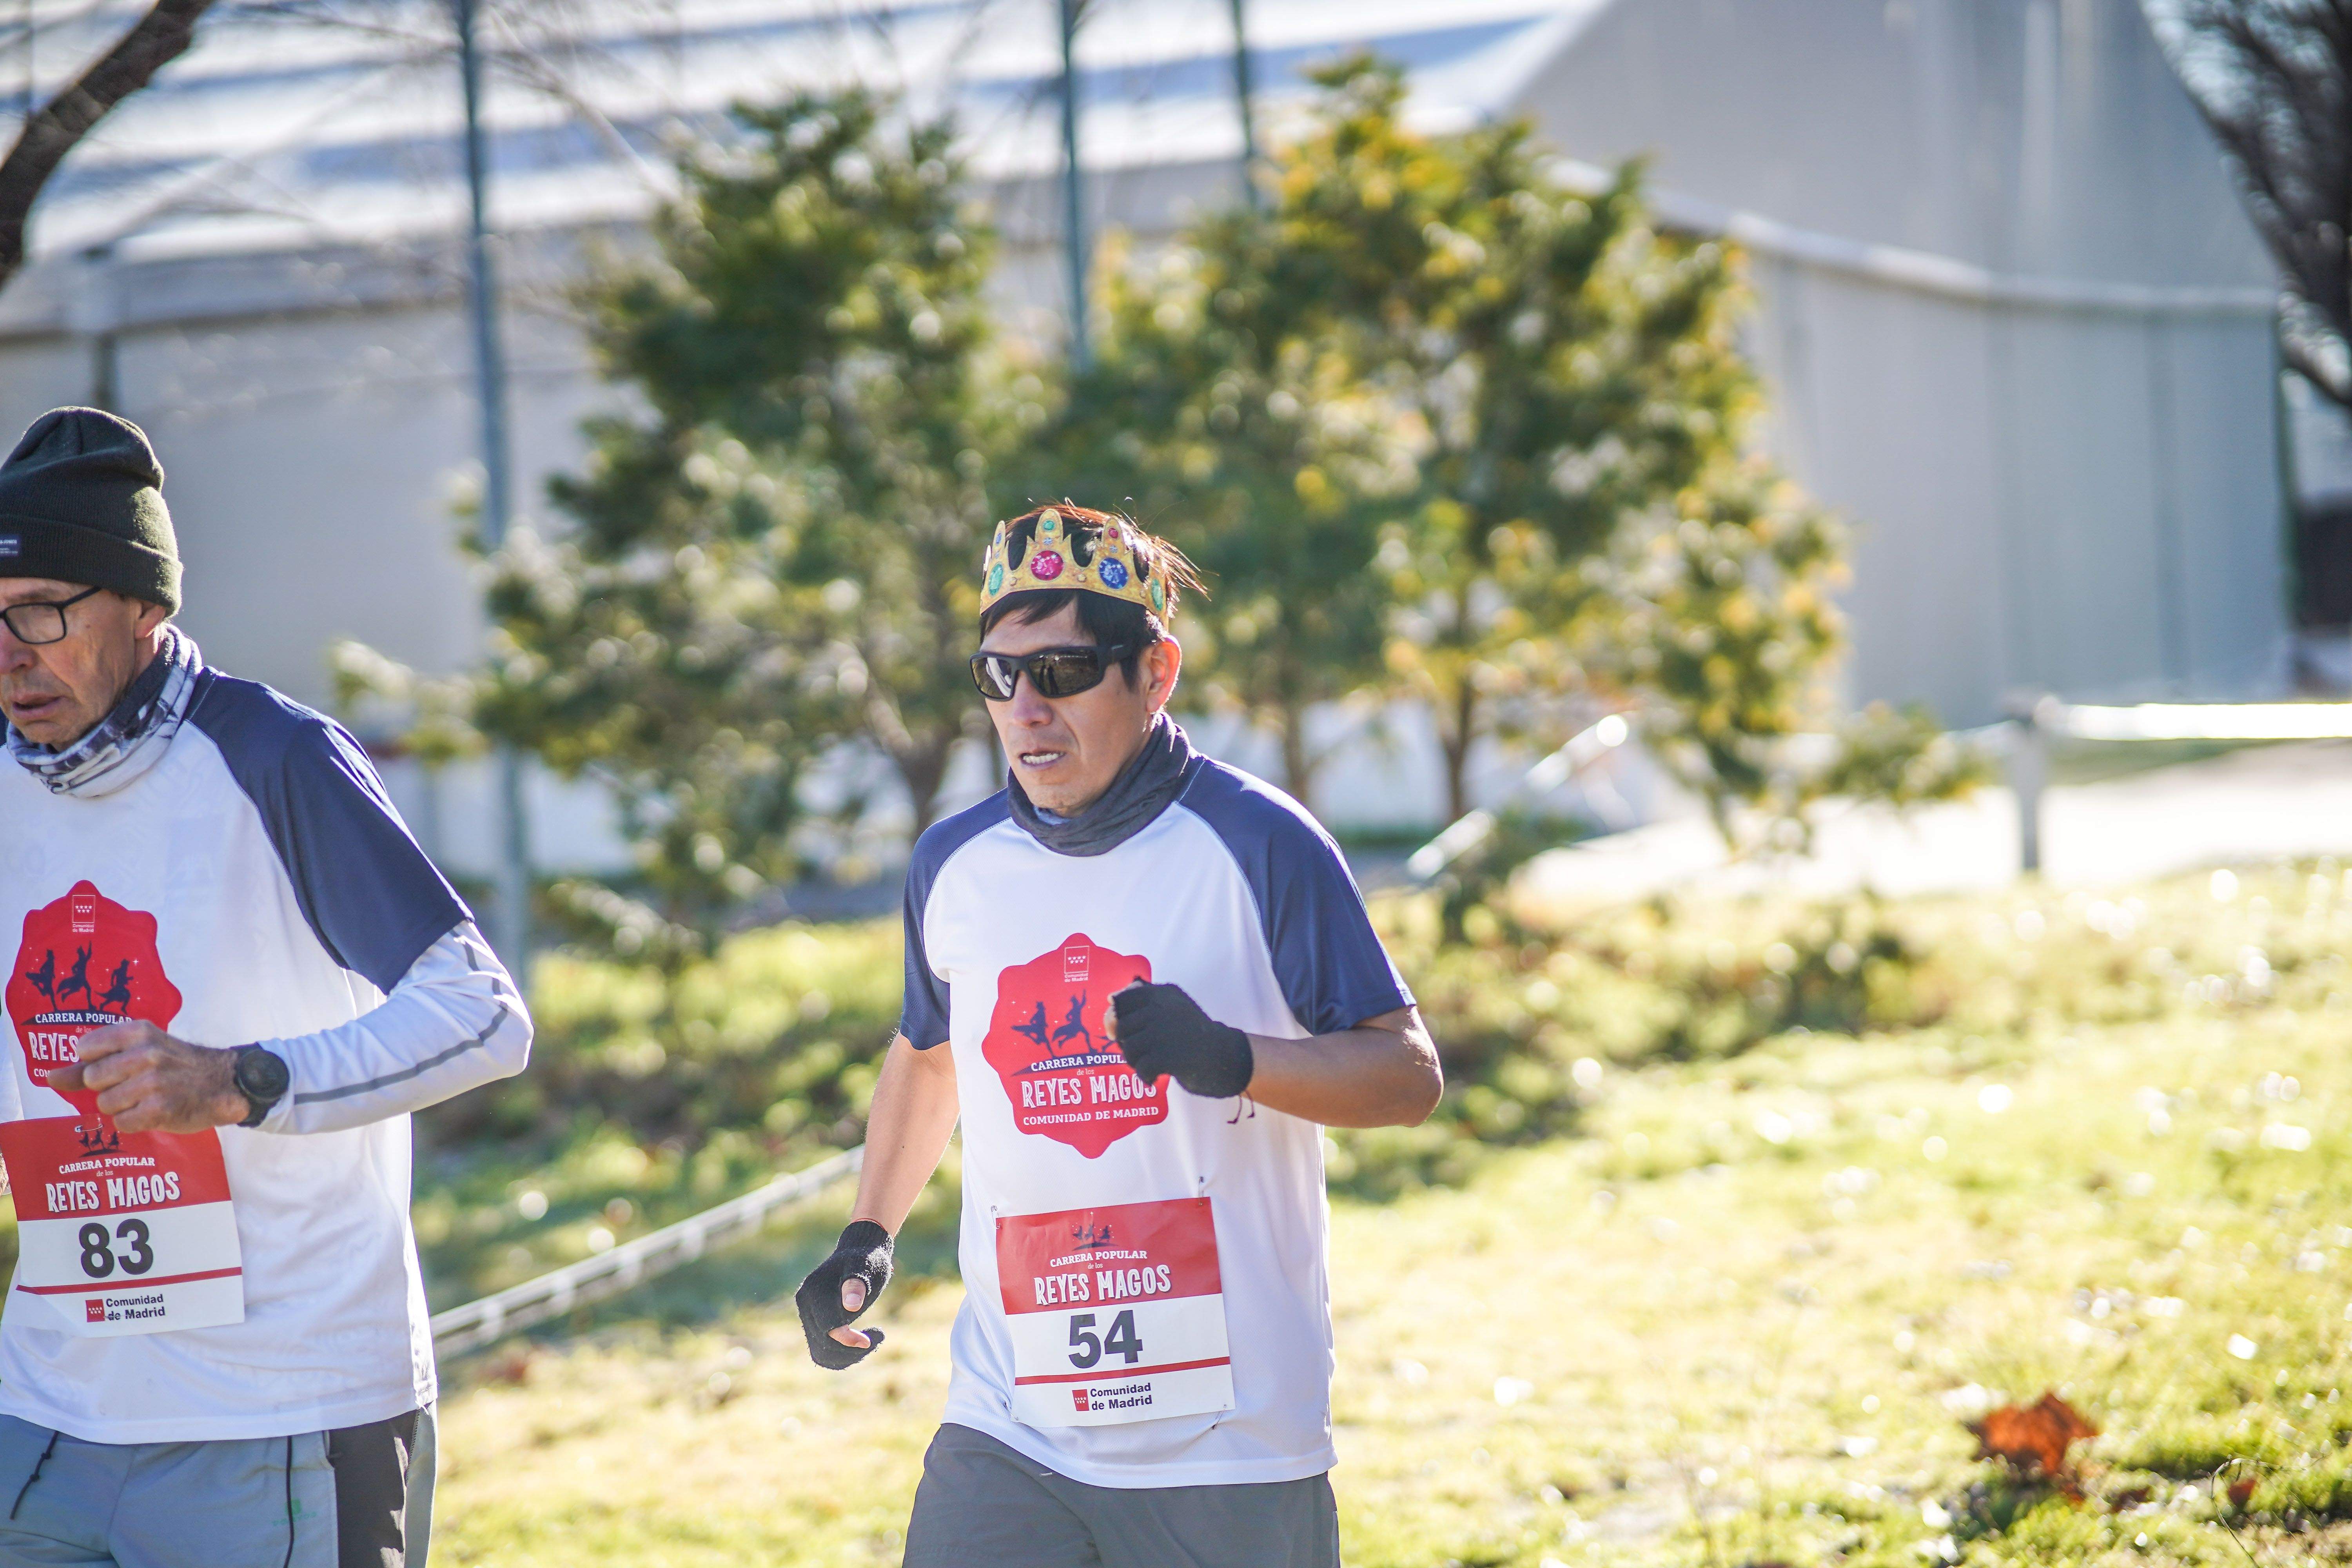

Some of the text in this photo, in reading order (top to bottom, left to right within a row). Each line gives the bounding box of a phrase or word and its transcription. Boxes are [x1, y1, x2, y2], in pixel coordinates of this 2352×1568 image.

[35, 1013, 83, 1023] CARRERA
[28, 1032, 80, 1062] REYES
[1031, 1055, 1127, 1071] CARRERA POPUL
[1021, 1078, 1082, 1108] REYES
[1023, 1107, 1159, 1125] COMUNIDAD DE MADRID
[59, 1157, 156, 1174] CARRERA POPULAR
[45, 1171, 180, 1212] REYES MAGOS
[79, 1218, 153, 1278] 83
[1050, 1250, 1147, 1267] CARRERA POPULAR
[1034, 1264, 1171, 1305] REYES MAGOS
[106, 1294, 164, 1307] Comunidad
[108, 1306, 166, 1321] de Madrid
[1068, 1310, 1143, 1368] 54
[1090, 1383, 1151, 1397] Comunidad
[1091, 1395, 1152, 1410] de Madrid
